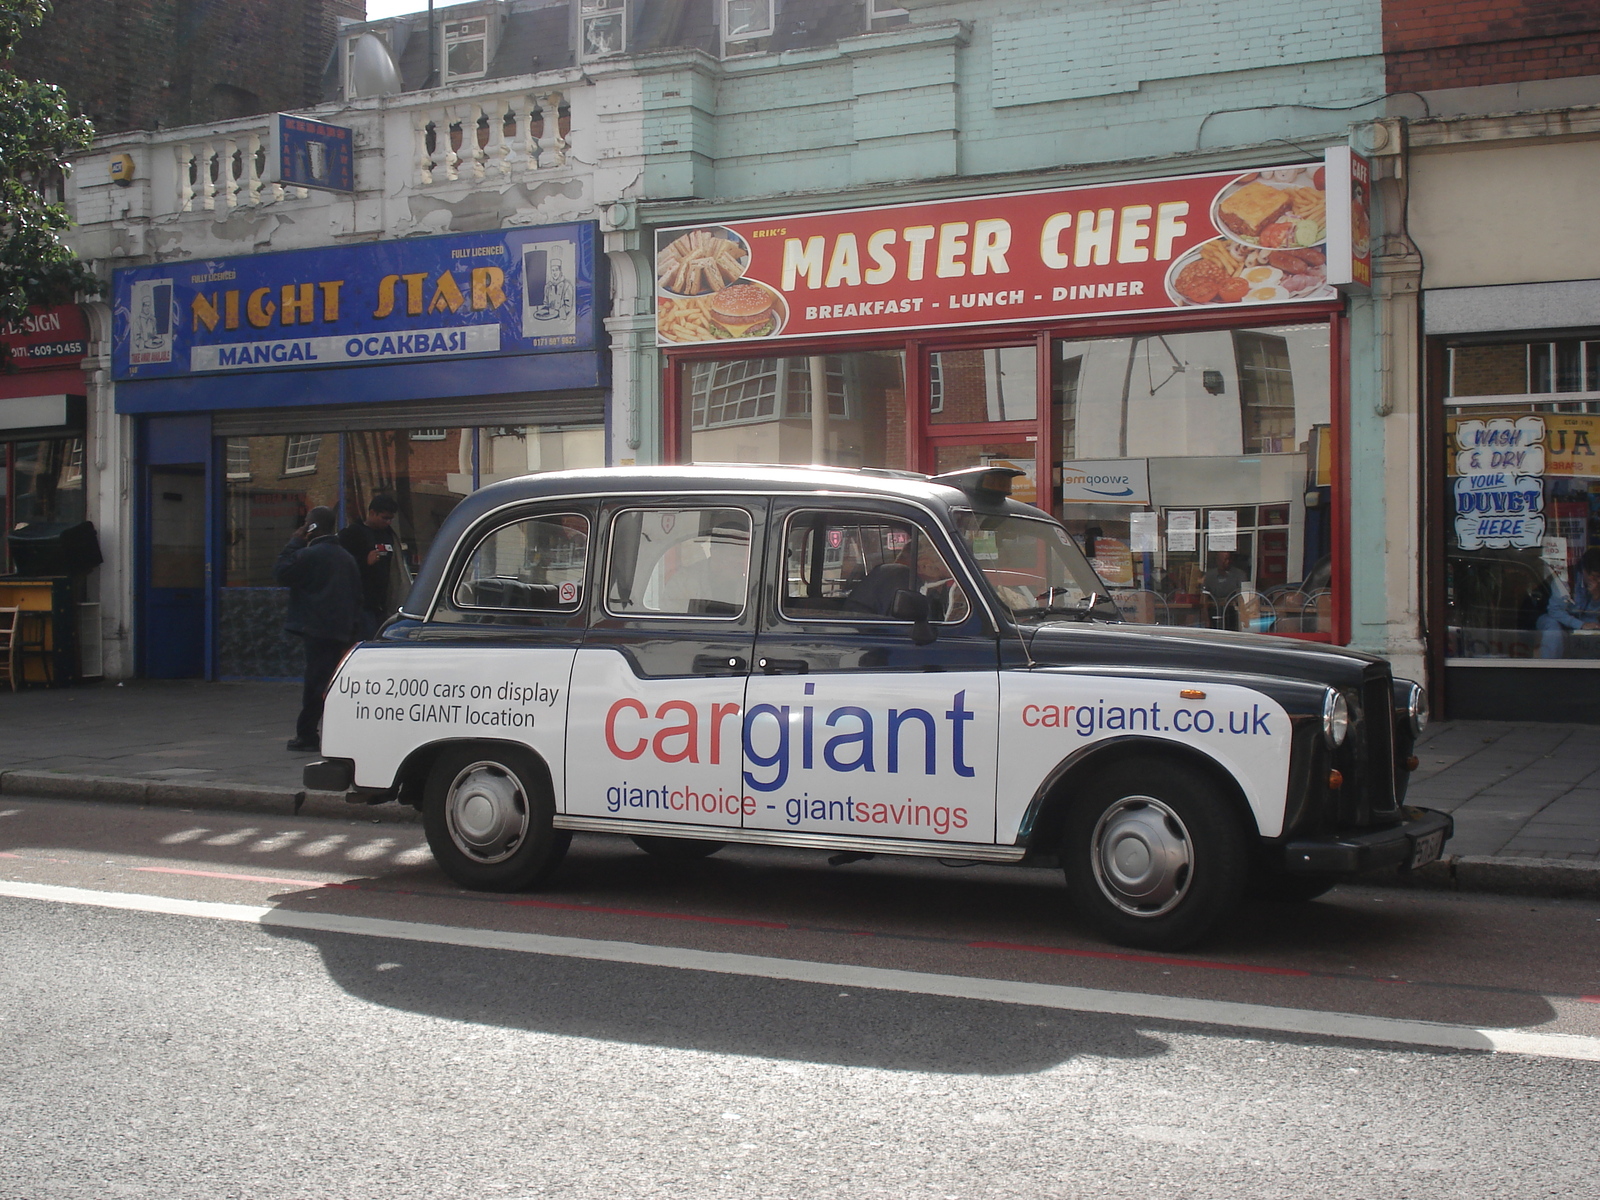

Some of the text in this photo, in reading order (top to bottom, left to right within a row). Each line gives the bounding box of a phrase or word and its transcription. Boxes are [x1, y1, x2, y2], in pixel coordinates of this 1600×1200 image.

[285, 119, 346, 139] KEBABS
[1352, 158, 1367, 184] CAFE
[753, 227, 787, 239] ERIK'S
[452, 245, 504, 258] FULLY LICENCED
[781, 200, 1189, 291] MASTER CHEF
[191, 271, 236, 283] FULLY LICENCED
[1353, 259, 1369, 282] OPEN
[191, 266, 507, 333] NIGHT STAR
[806, 297, 922, 321] BREAKFAST
[949, 289, 1025, 310] LUNCH
[1052, 280, 1145, 303] DINNER
[8, 312, 61, 335] DSIGN
[219, 331, 466, 367] MANGAL OCAKBASI
[1475, 429, 1522, 447] WASH
[1470, 450, 1526, 469] & DRY
[1470, 473, 1505, 489] YOUR
[1457, 490, 1541, 514] DUVET
[1477, 519, 1524, 535] HERE
[339, 676, 560, 708] Up to 2,000 cars on display
[356, 702, 535, 728] in one GIANT location
[1021, 699, 1271, 736] cargiant.co.uk
[603, 682, 975, 793] cargiant
[606, 783, 756, 817] giantchoice
[785, 794, 969, 835] giantsavings
